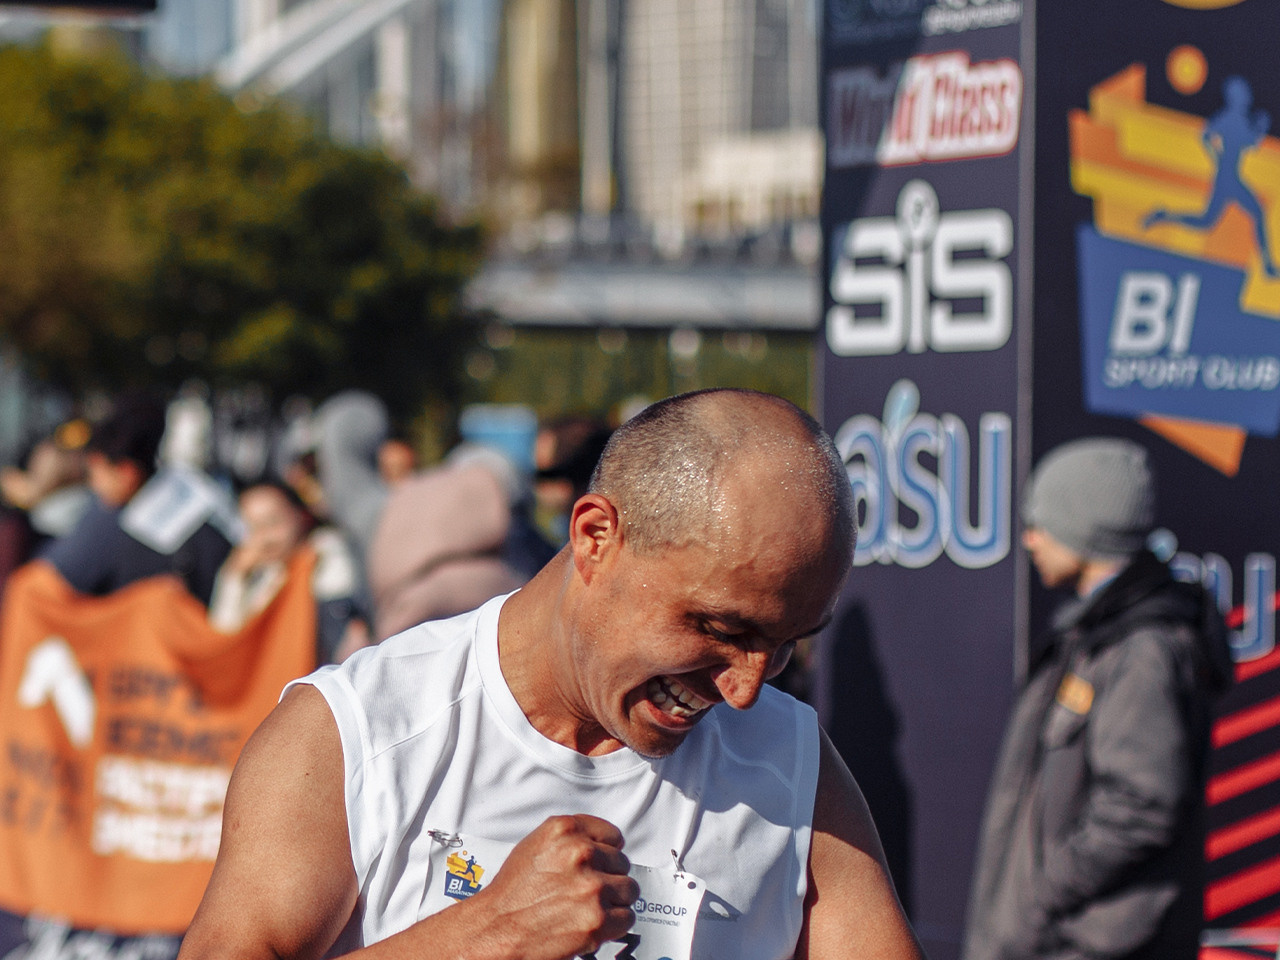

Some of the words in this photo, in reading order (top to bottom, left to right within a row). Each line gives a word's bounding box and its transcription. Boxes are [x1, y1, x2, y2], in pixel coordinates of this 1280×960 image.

[1110, 272, 1201, 357] BI
[1102, 355, 1200, 390] SPORT
[1202, 354, 1280, 391] CLUB
[449, 878, 463, 891] BI
[635, 899, 645, 911] BI
[647, 902, 688, 916] GROUP
